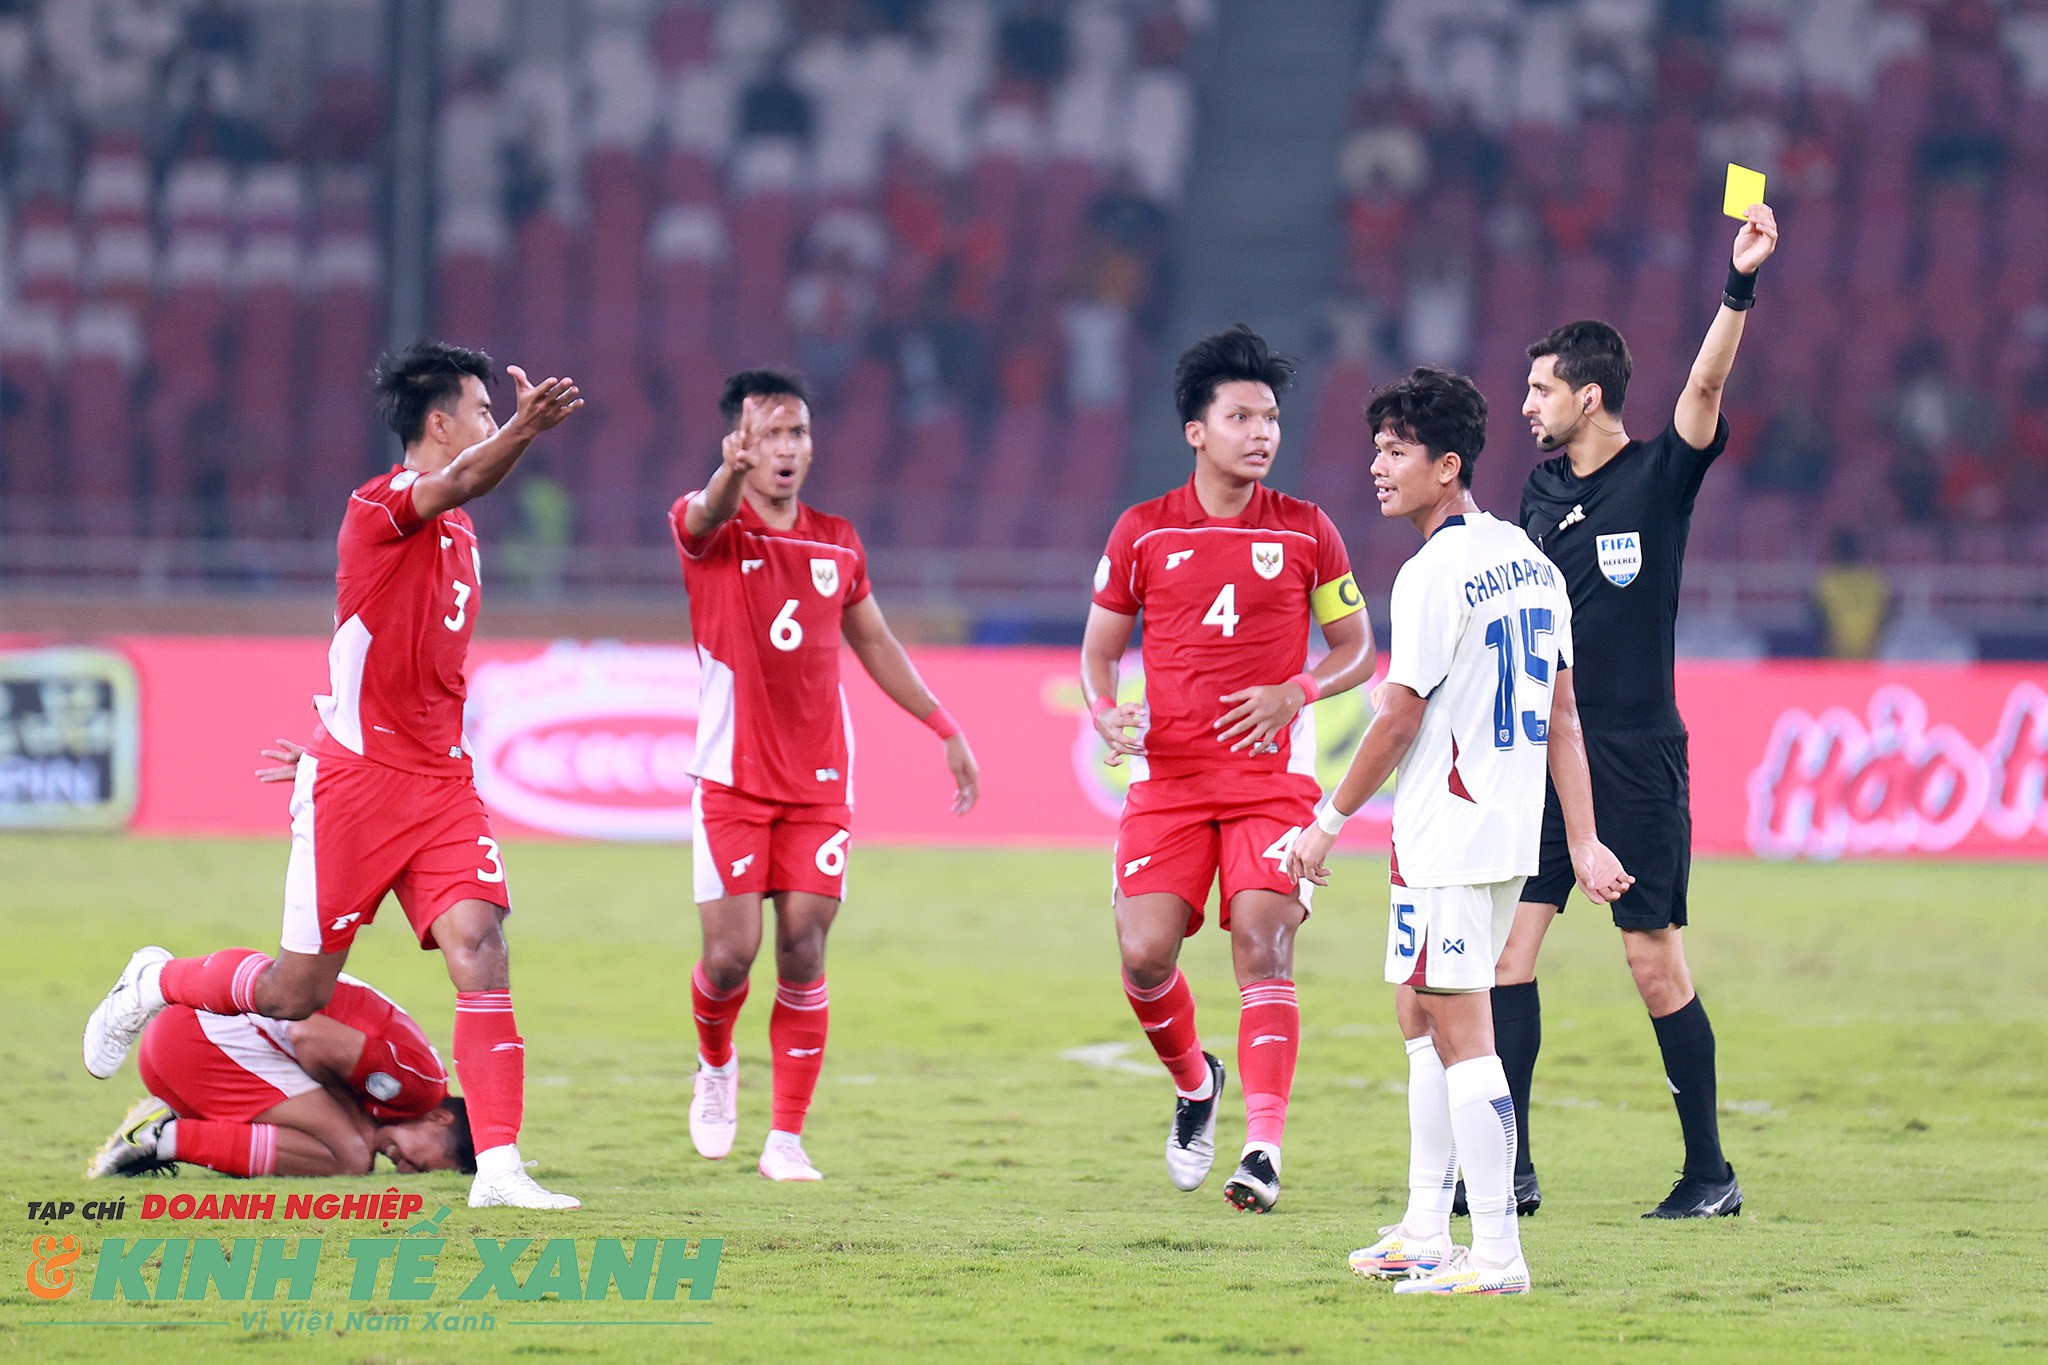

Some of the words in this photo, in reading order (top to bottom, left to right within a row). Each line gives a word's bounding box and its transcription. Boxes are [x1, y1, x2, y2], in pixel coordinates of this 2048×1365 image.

[1601, 537, 1636, 551] FIFA
[1603, 556, 1638, 566] REFEREE
[443, 579, 472, 632] 3
[769, 598, 803, 652] 6
[1201, 583, 1241, 638] 4
[1485, 607, 1555, 751] 15
[476, 835, 504, 883] 3
[815, 829, 850, 876] 6
[1261, 825, 1303, 874] 4
